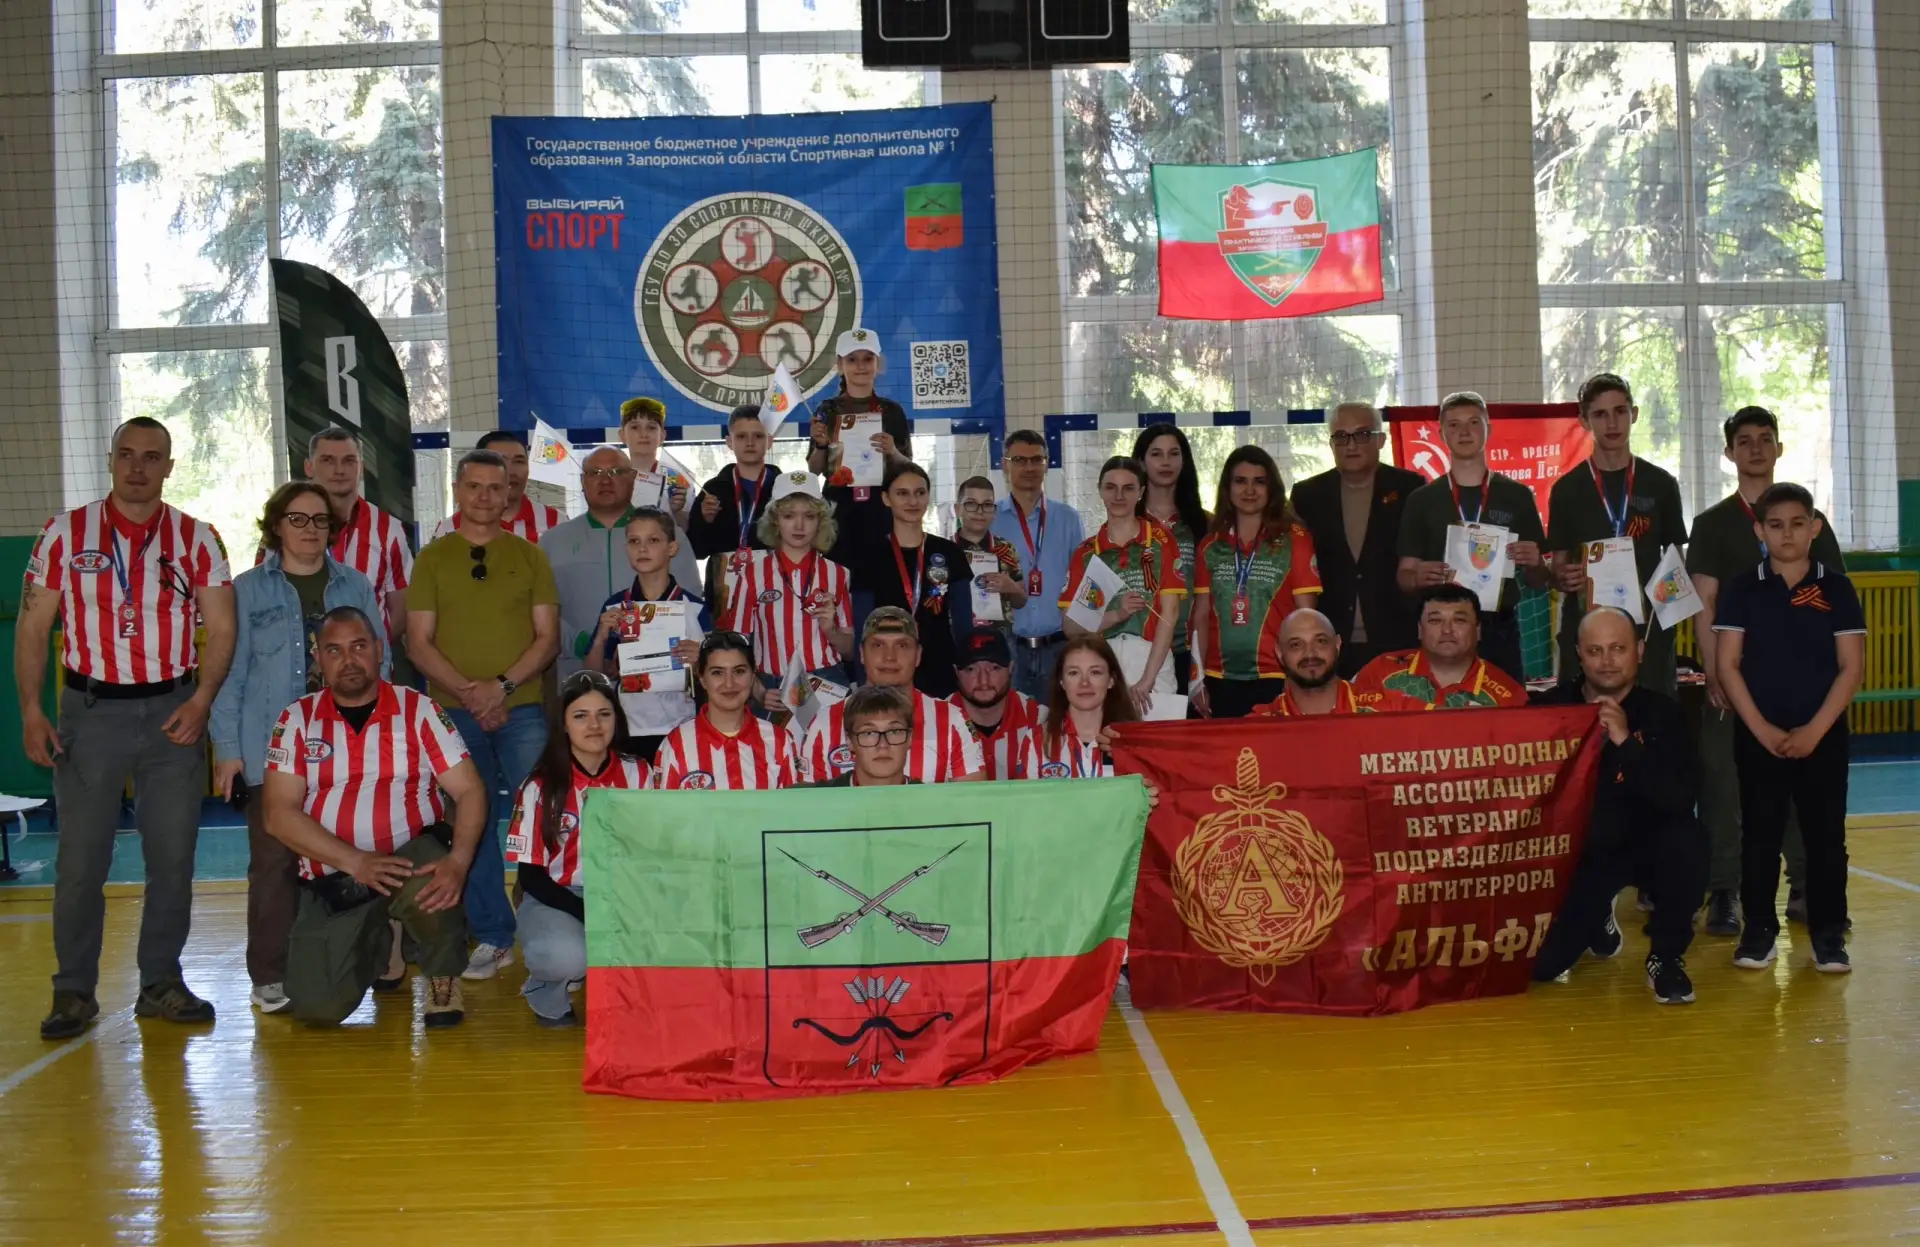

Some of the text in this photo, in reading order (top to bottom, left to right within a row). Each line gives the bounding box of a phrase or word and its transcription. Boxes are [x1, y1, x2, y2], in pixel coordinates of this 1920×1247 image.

[526, 127, 960, 152] Государственное бюджетное учреждение дополнительного
[530, 141, 955, 169] образования Запорожской области Спортивная школа № 1
[526, 196, 624, 210] ВЫБИРАЙ
[526, 211, 624, 250] СПОРТ
[644, 275, 661, 305] ГБУ
[657, 251, 672, 272] ДО
[691, 198, 793, 229] СПОРТИВНАЯ
[797, 217, 842, 264] ШКОЛА
[1522, 444, 1560, 459] ОРДЕНА
[1588, 542, 1605, 564] 9
[640, 603, 657, 624] 9
[807, 602, 817, 612] 2
[1236, 612, 1244, 621] 3
[125, 622, 135, 632] 2
[628, 625, 633, 634] 1
[1360, 738, 1582, 775] МЕЖДУНАРОДНАЯ
[1393, 773, 1557, 805] АССОЦИАЦИЯ
[1406, 807, 1542, 838] ВЕТЕРАНОВ
[1374, 834, 1571, 874] ПОДРАЗДЕЛЕНИЯ
[1396, 868, 1556, 905] АНТИТЕРРОРА
